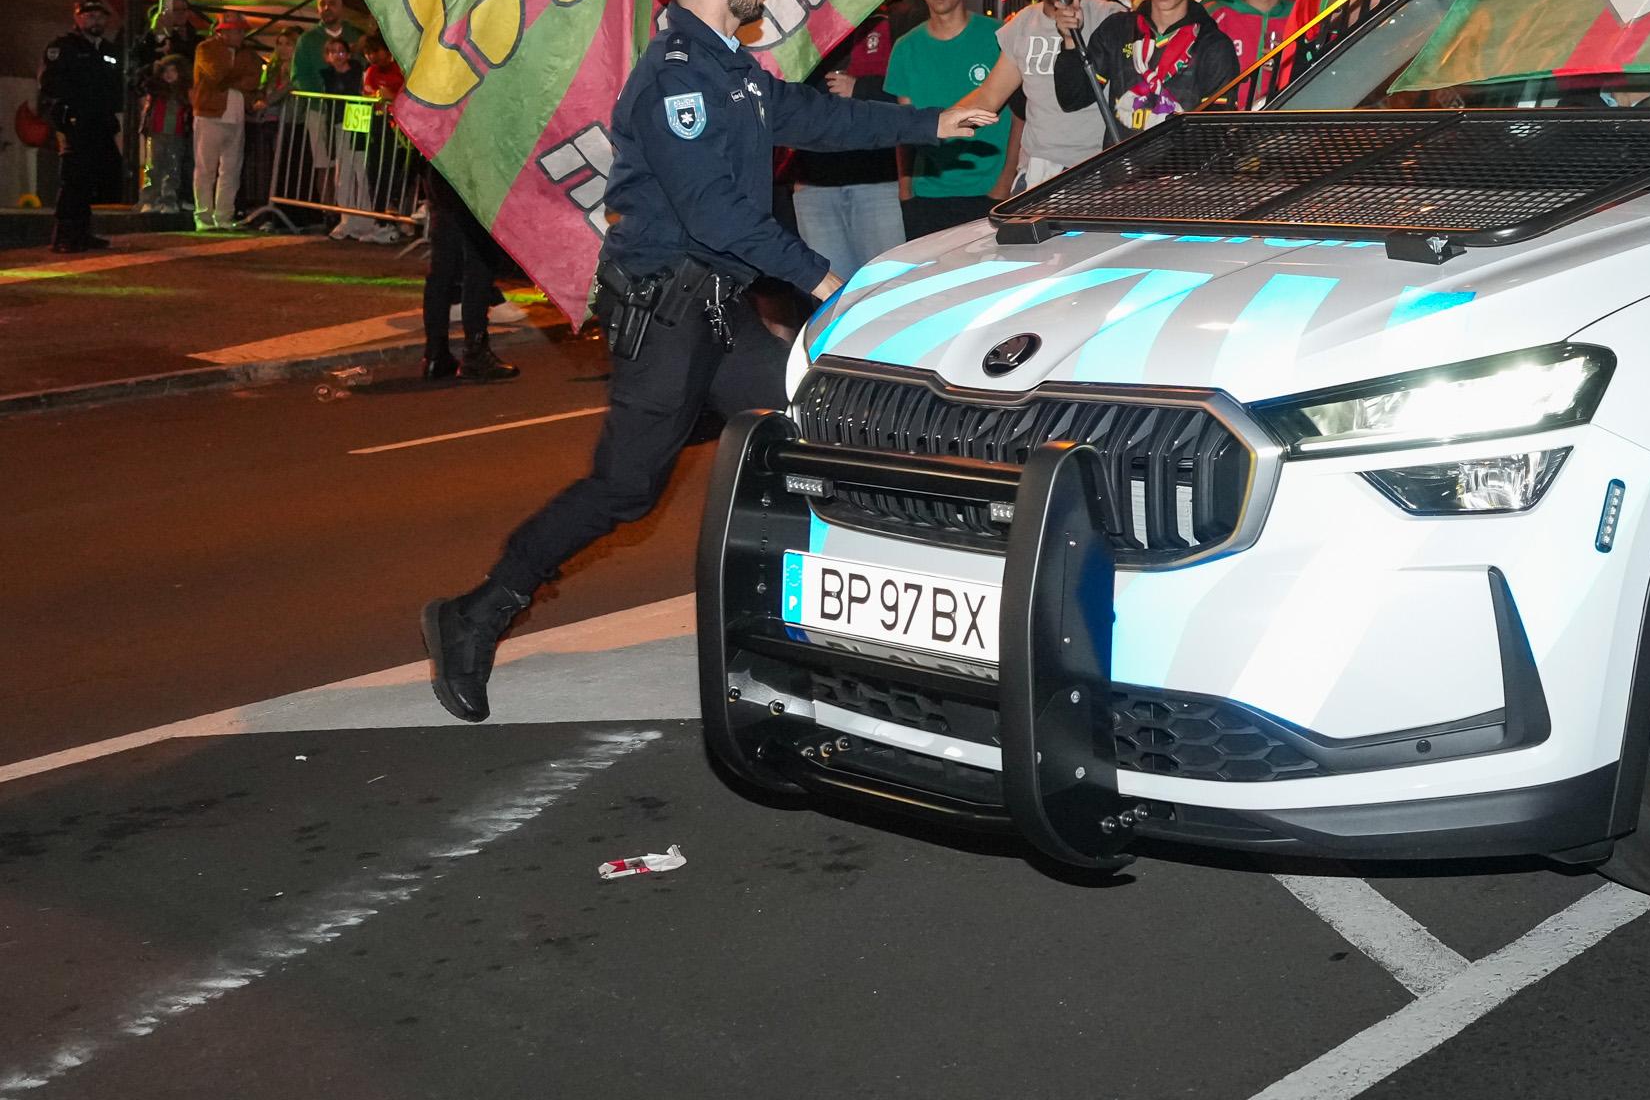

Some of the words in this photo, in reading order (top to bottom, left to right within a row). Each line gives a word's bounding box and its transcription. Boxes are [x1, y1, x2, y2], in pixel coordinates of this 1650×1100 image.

[789, 596, 798, 611] P
[820, 567, 871, 625] BP
[880, 578, 923, 635] 97
[931, 587, 987, 649] BX
